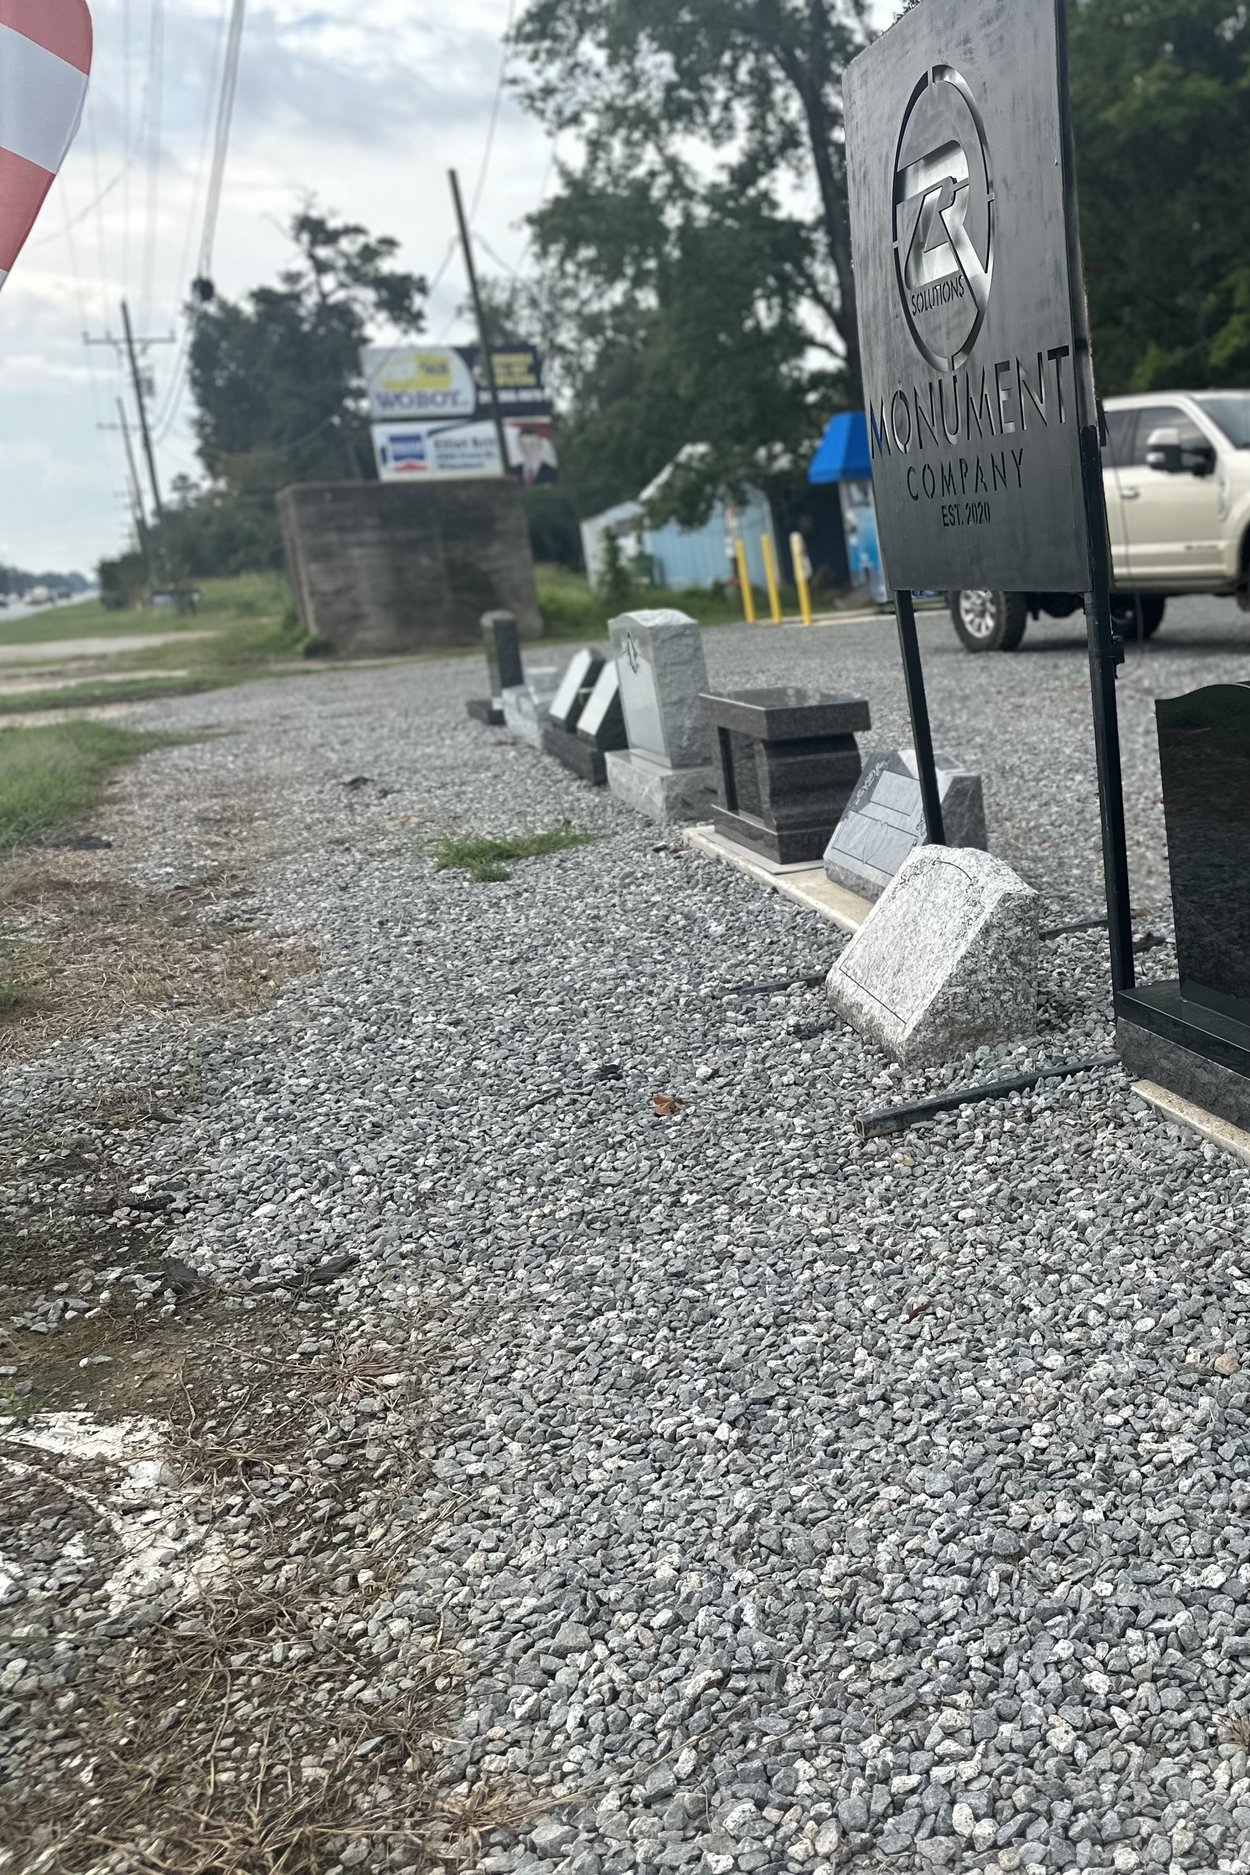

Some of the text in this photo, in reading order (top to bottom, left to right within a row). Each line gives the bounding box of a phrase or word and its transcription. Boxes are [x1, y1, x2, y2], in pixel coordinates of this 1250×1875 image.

[911, 274, 965, 316] SOLUTIONS
[869, 345, 1070, 460] MONUMENT
[906, 447, 1024, 501] COMPANY
[941, 501, 991, 528] EST. 2020
